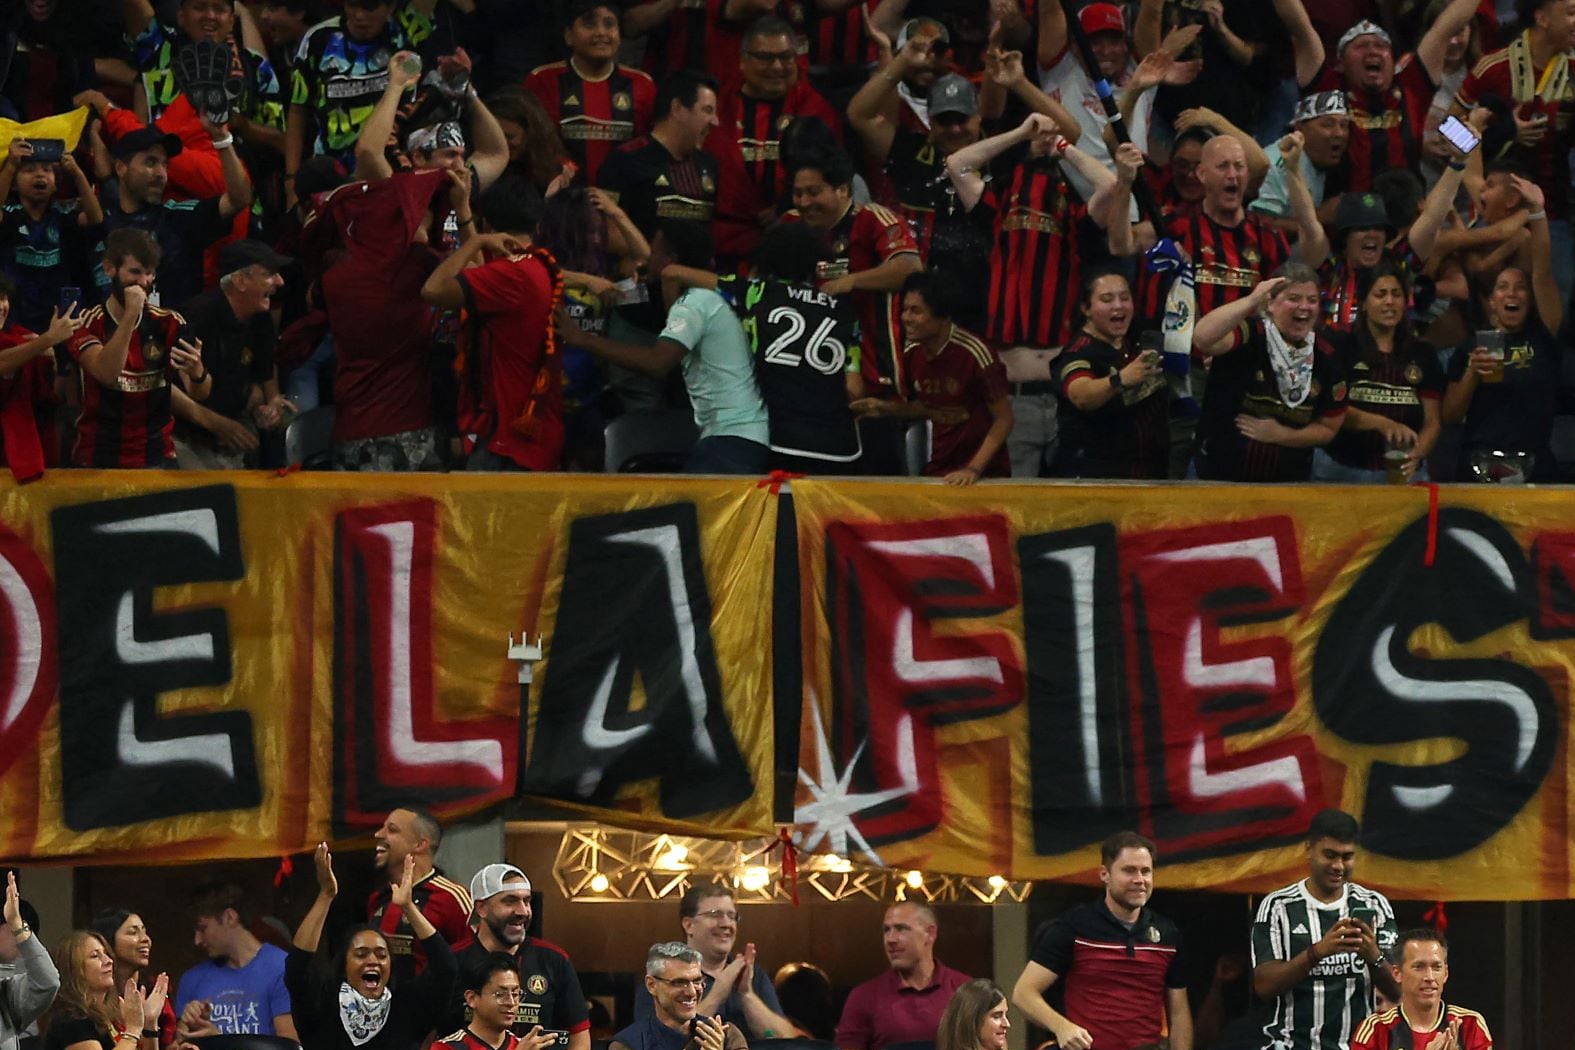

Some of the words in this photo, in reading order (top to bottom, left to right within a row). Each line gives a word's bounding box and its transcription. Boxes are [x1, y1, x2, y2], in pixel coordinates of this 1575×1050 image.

[787, 286, 838, 309] WILEY
[765, 306, 846, 375] 26
[335, 497, 757, 842] LA
